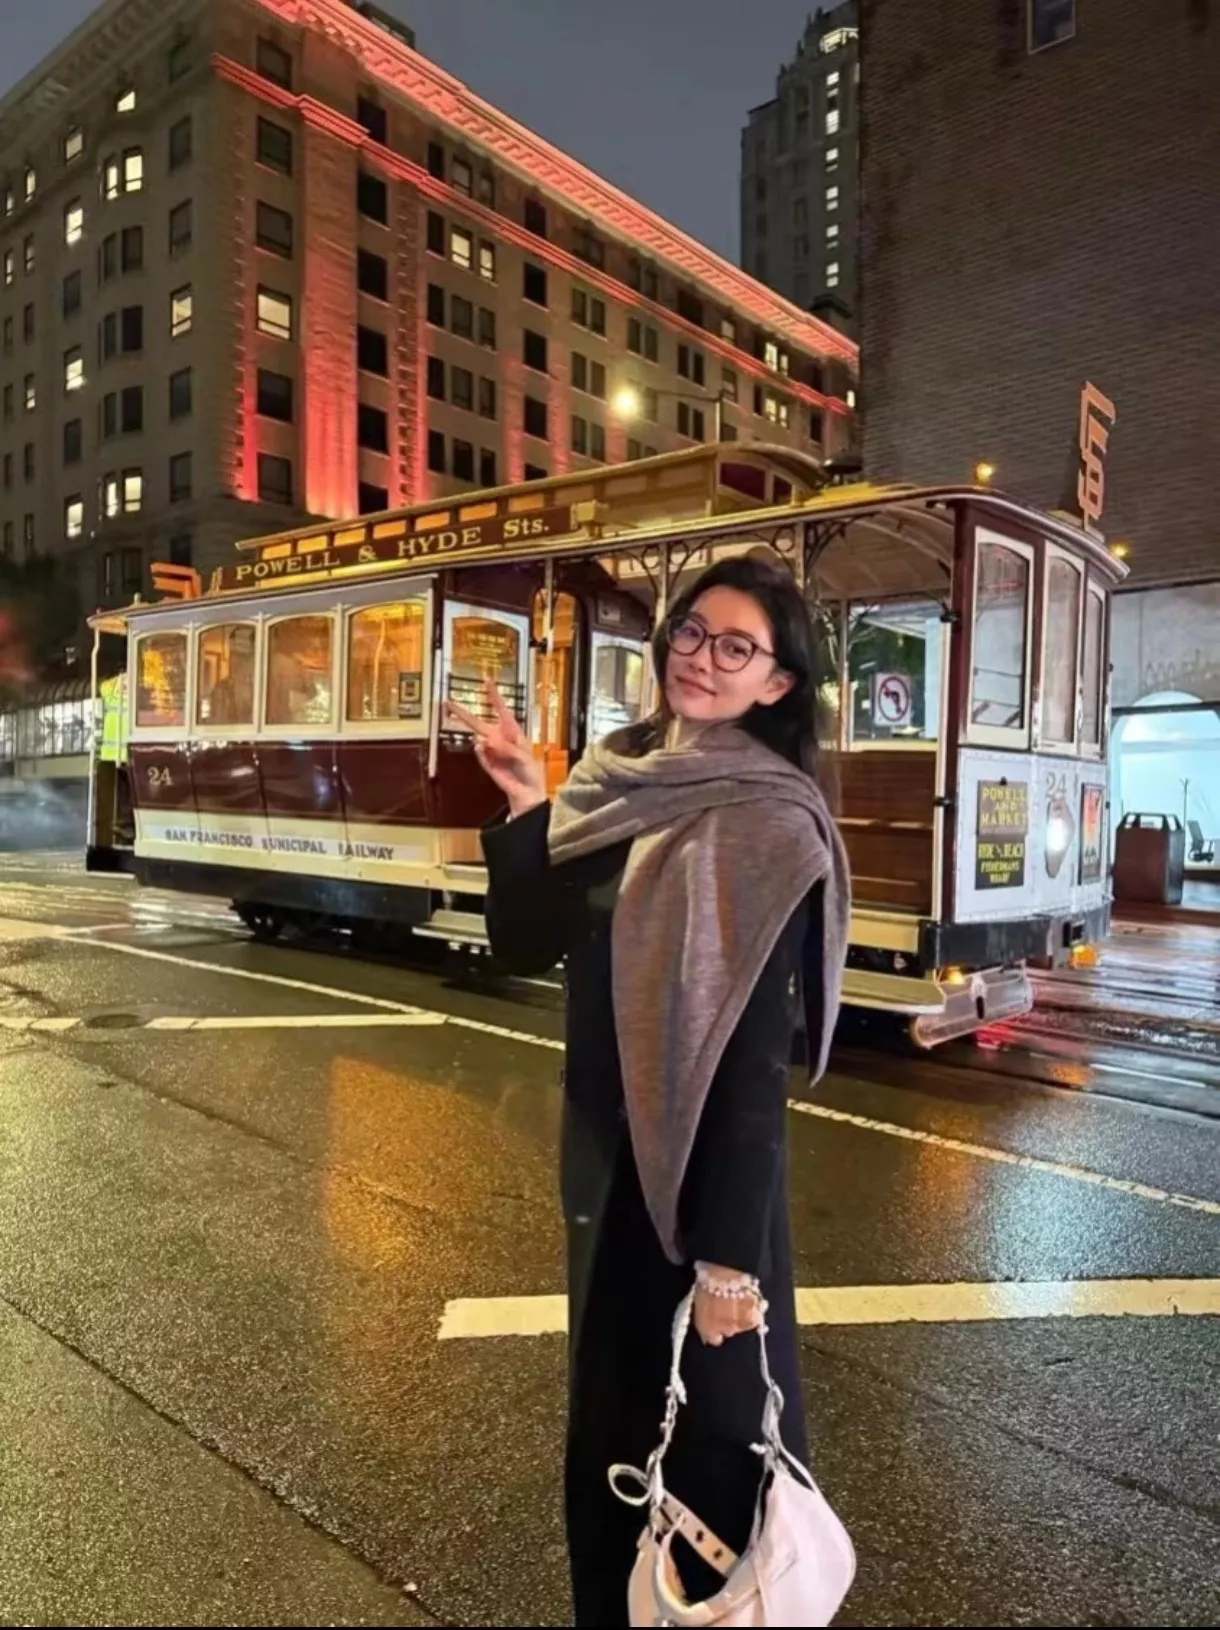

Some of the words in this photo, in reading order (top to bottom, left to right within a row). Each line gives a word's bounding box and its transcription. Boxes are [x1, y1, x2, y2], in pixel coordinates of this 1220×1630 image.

[235, 550, 340, 581] POWELL
[358, 545, 378, 563] &
[397, 526, 482, 558] HYDE
[503, 516, 549, 539] Sts.
[147, 767, 173, 786] 24
[1046, 772, 1067, 797] 24
[981, 786, 1025, 800] POWELL
